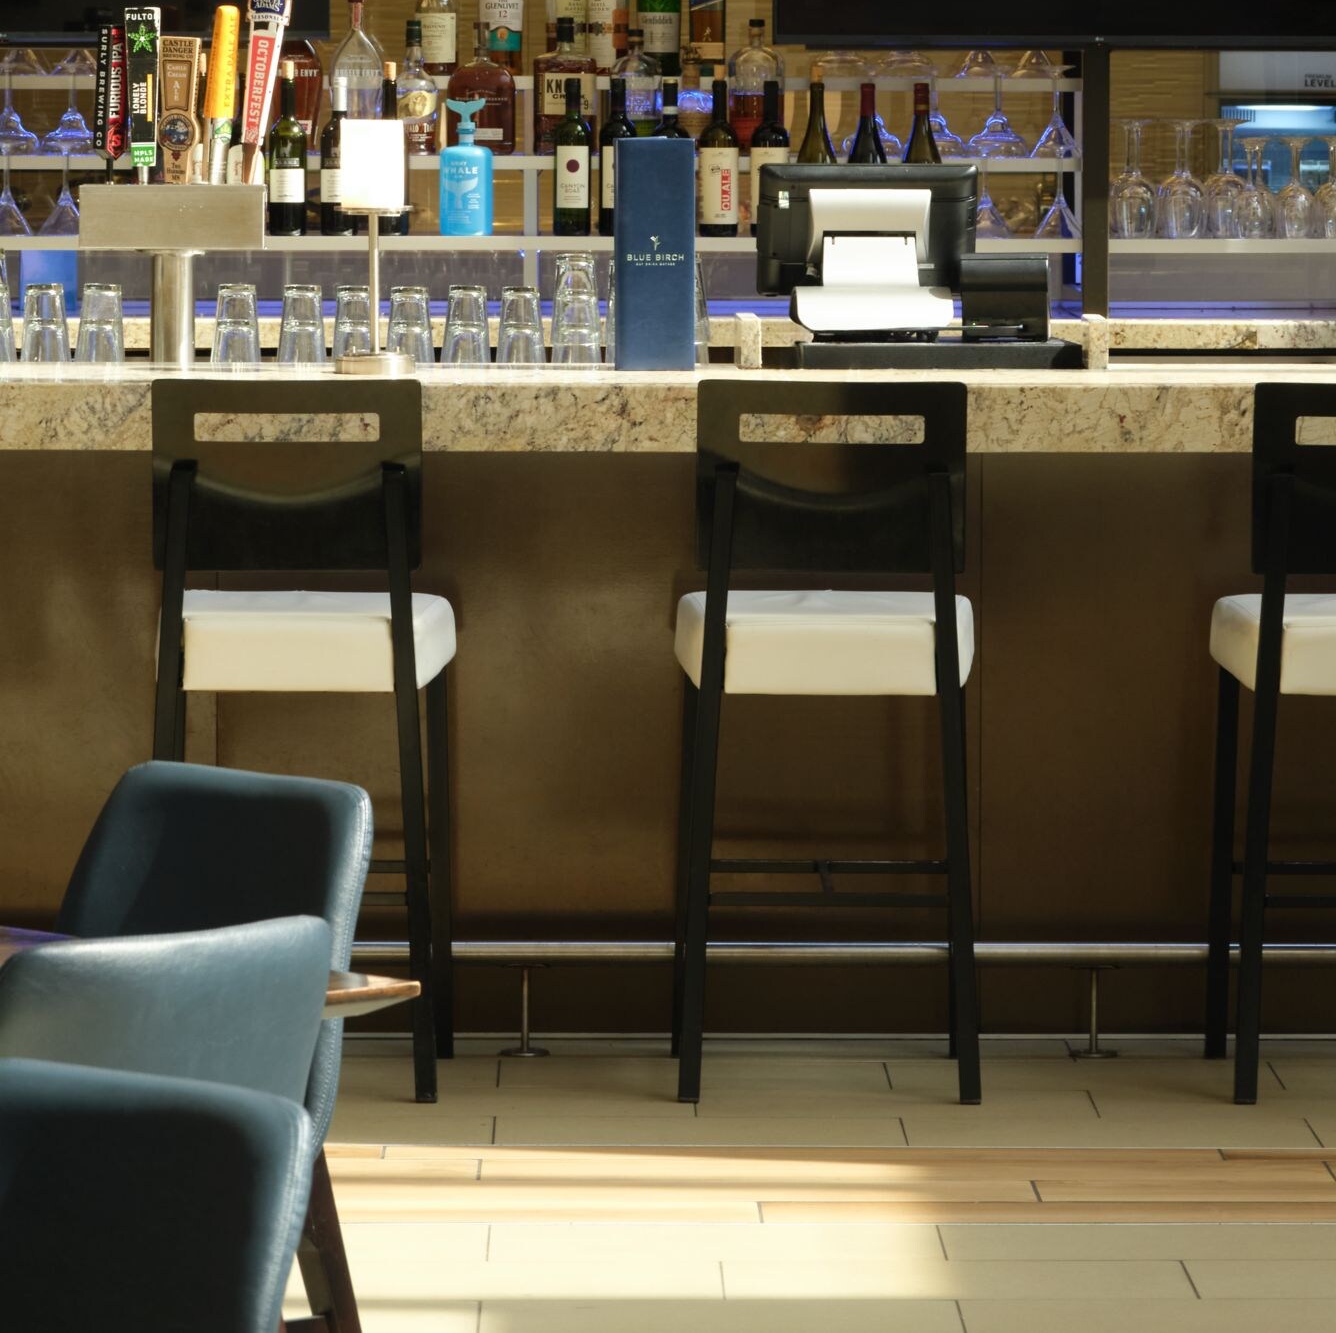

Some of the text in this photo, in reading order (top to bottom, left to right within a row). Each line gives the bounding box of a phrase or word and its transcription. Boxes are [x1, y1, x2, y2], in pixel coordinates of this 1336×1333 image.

[254, 1, 280, 12] ADAMS
[485, 2, 519, 10] GLENLIVET
[126, 13, 158, 21] FULTO
[498, 10, 508, 18] 12
[300, 68, 319, 77] ENVY
[108, 41, 123, 119] FURIOUS IPA
[248, 39, 269, 125] OCTOBERFEST
[95, 28, 108, 147] SURLY BREWING CO
[132, 82, 140, 114] LONELY
[139, 81, 147, 115] BLONDE
[626, 253, 685, 262] BLUE BIRCH
